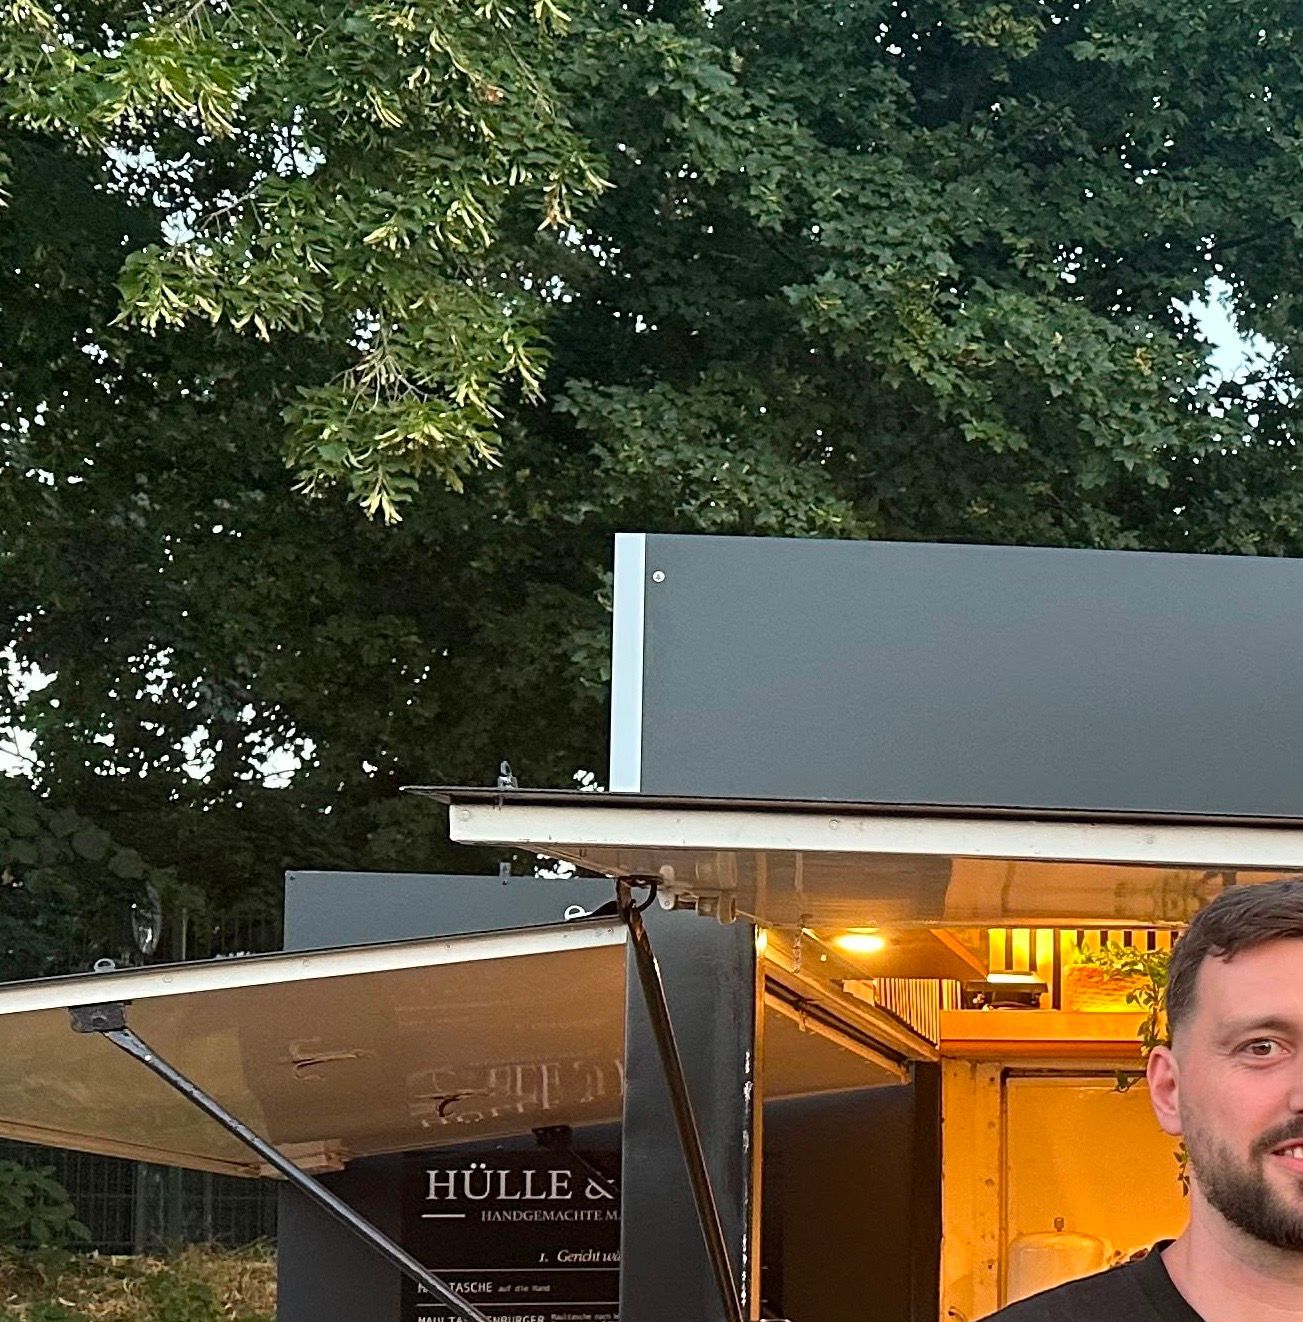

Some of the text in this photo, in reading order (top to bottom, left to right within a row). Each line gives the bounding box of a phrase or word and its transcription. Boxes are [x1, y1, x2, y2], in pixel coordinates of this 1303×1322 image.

[426, 1162, 573, 1201] HÜLLE
[481, 1209, 620, 1222] HANDGEMACHTE M
[557, 1248, 601, 1263] Gericht
